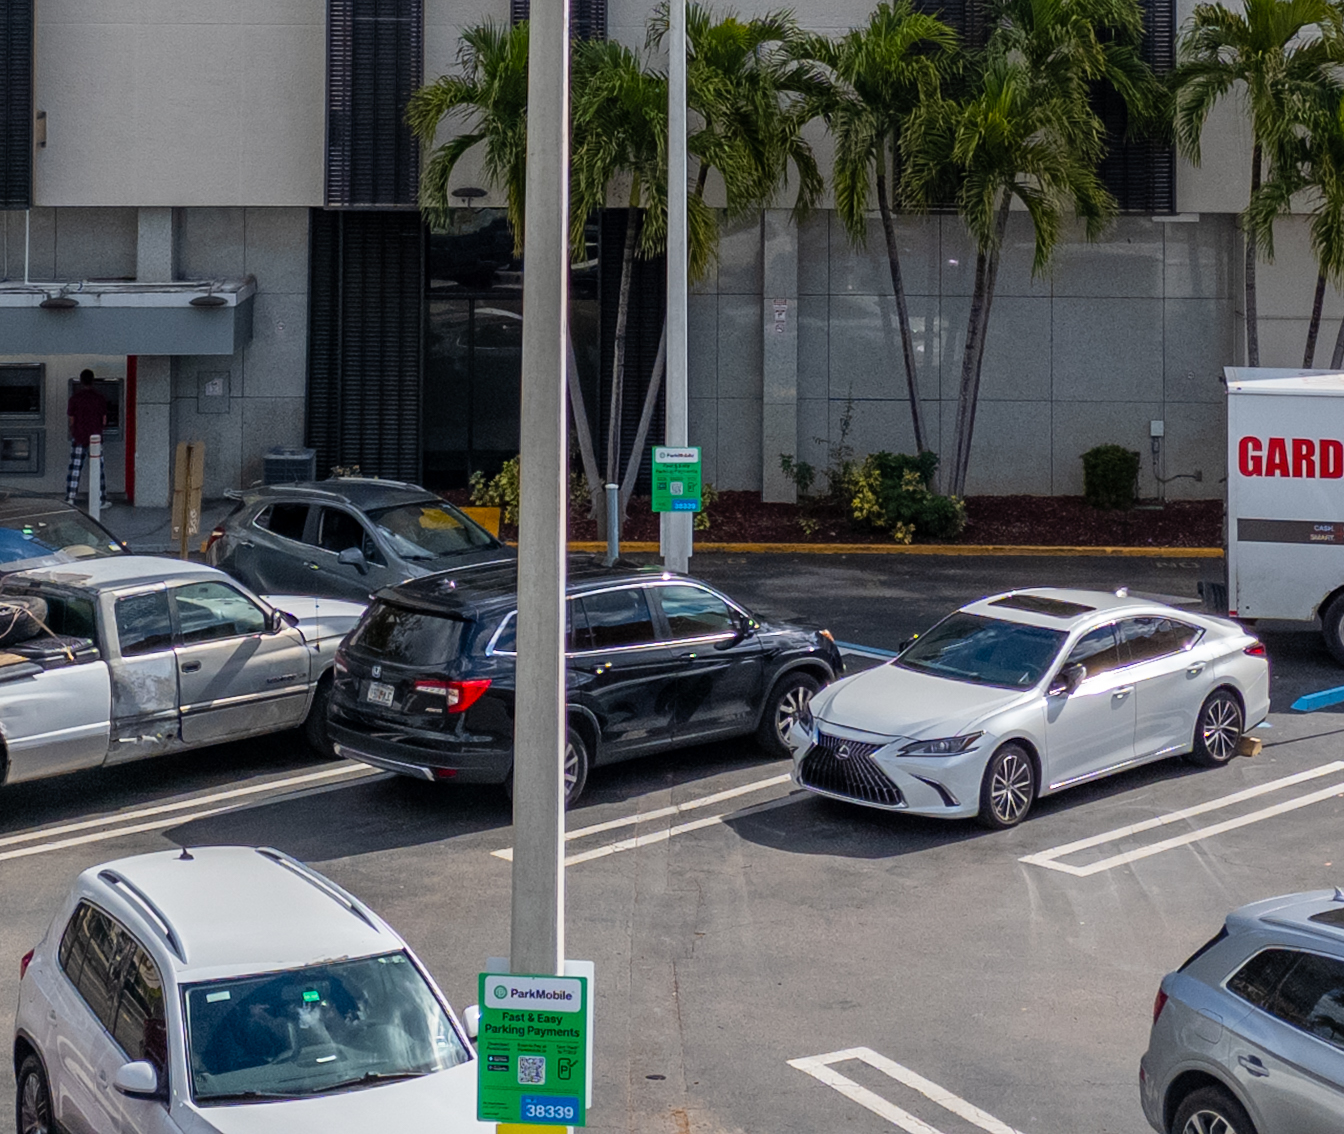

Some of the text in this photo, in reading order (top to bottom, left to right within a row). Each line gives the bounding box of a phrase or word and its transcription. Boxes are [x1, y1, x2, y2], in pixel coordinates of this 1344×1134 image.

[510, 988, 573, 1000] ParkMobile
[502, 1012, 563, 1026] Fast & Easy
[484, 1023, 580, 1038] Parking Payments
[525, 1104, 574, 1119] 38339
